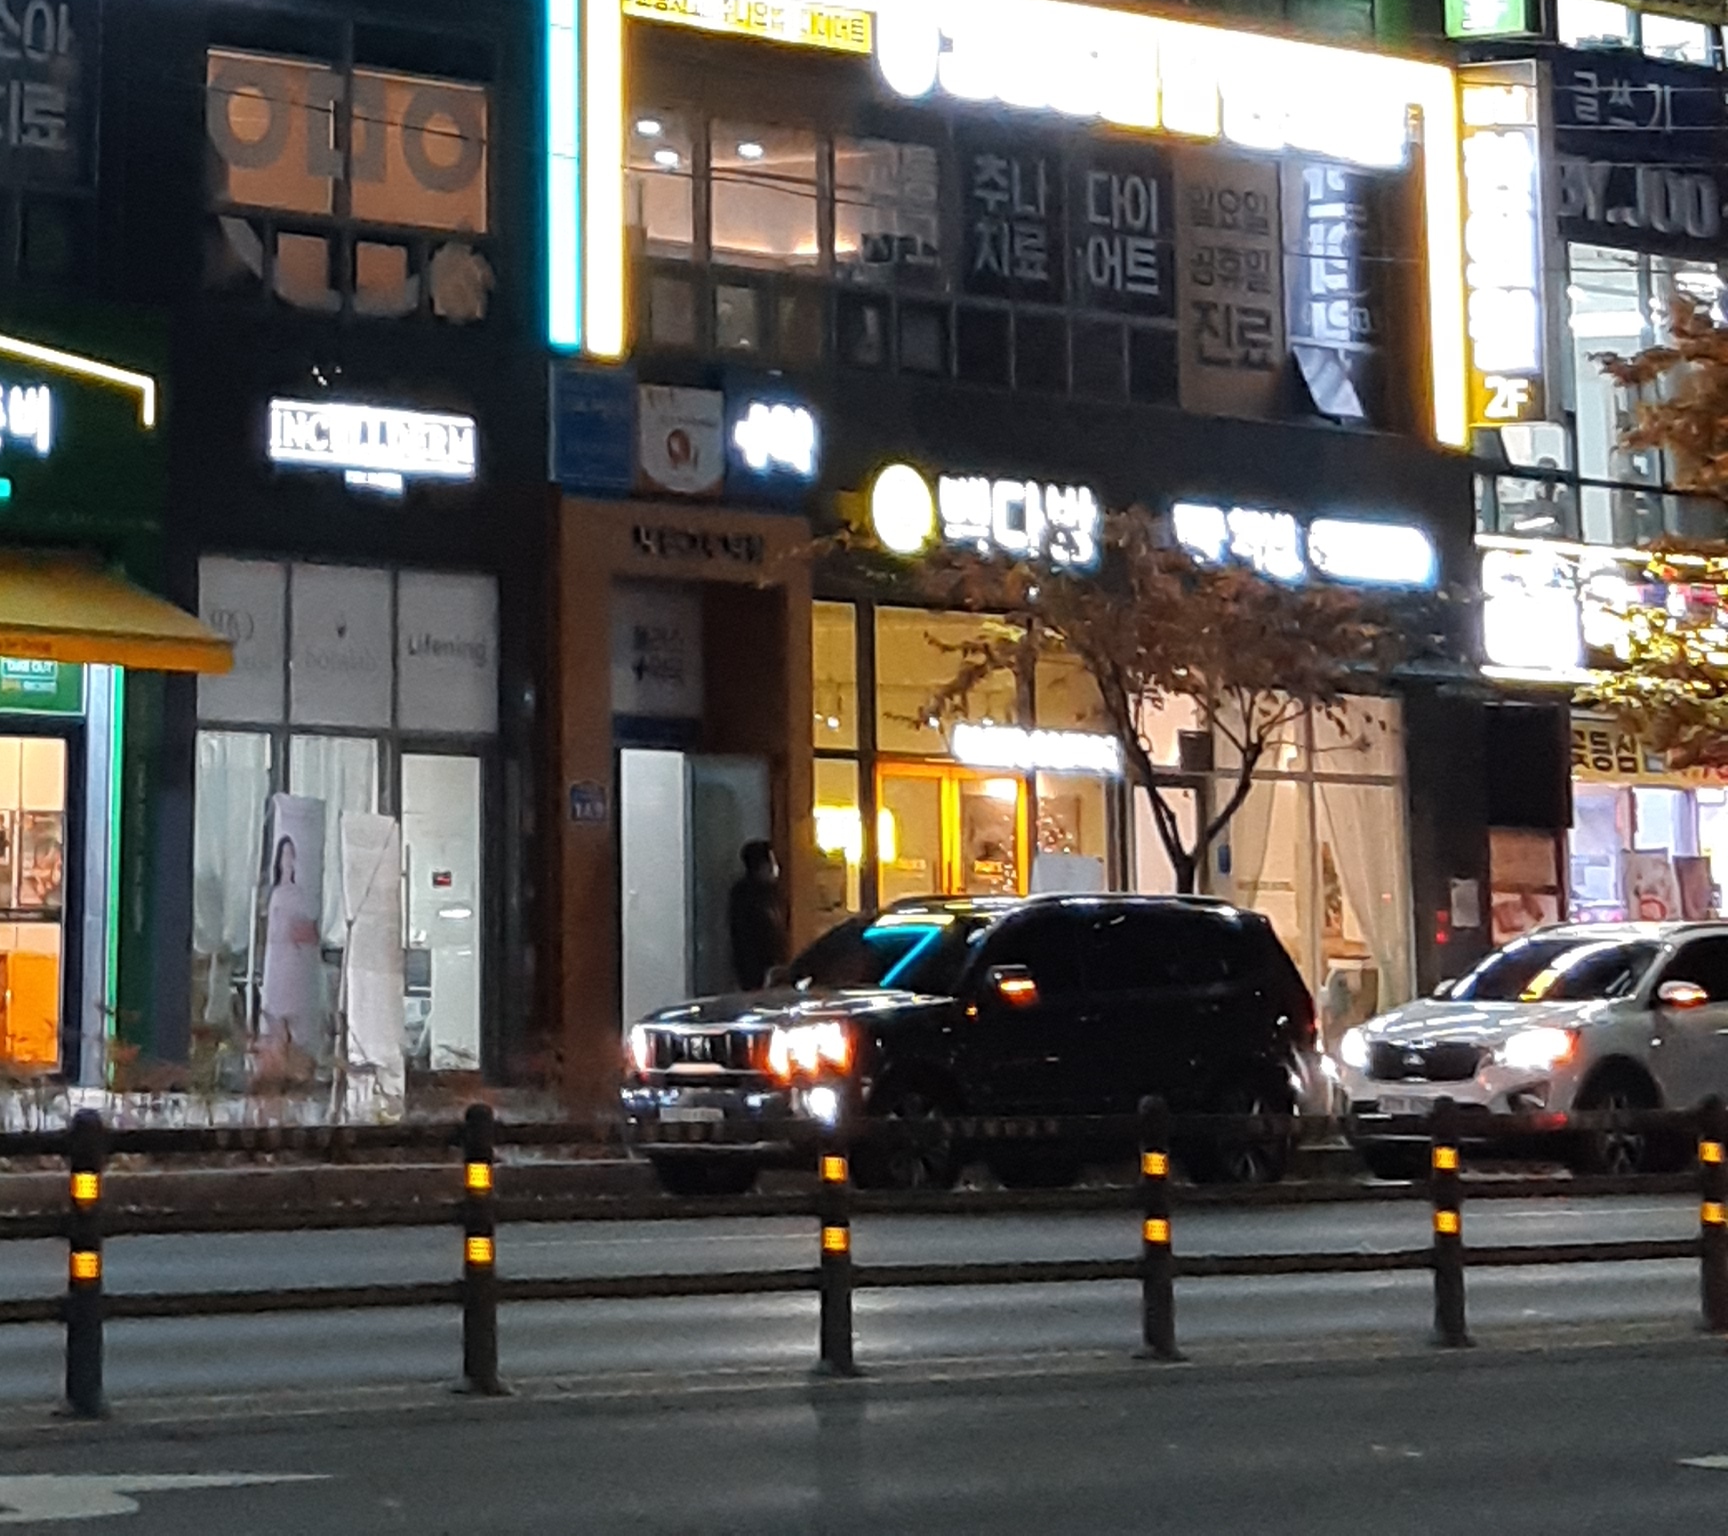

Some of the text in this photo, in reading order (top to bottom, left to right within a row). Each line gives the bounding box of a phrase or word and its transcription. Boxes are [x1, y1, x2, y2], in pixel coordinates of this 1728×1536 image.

[1574, 70, 1672, 136] 글쓰기
[971, 151, 1050, 216] 추나
[1086, 170, 1160, 234] 다이
[973, 218, 1050, 282] 치료
[1192, 300, 1276, 370] 진료
[1484, 376, 1531, 419] 2F
[939, 476, 1097, 561] 빽다방
